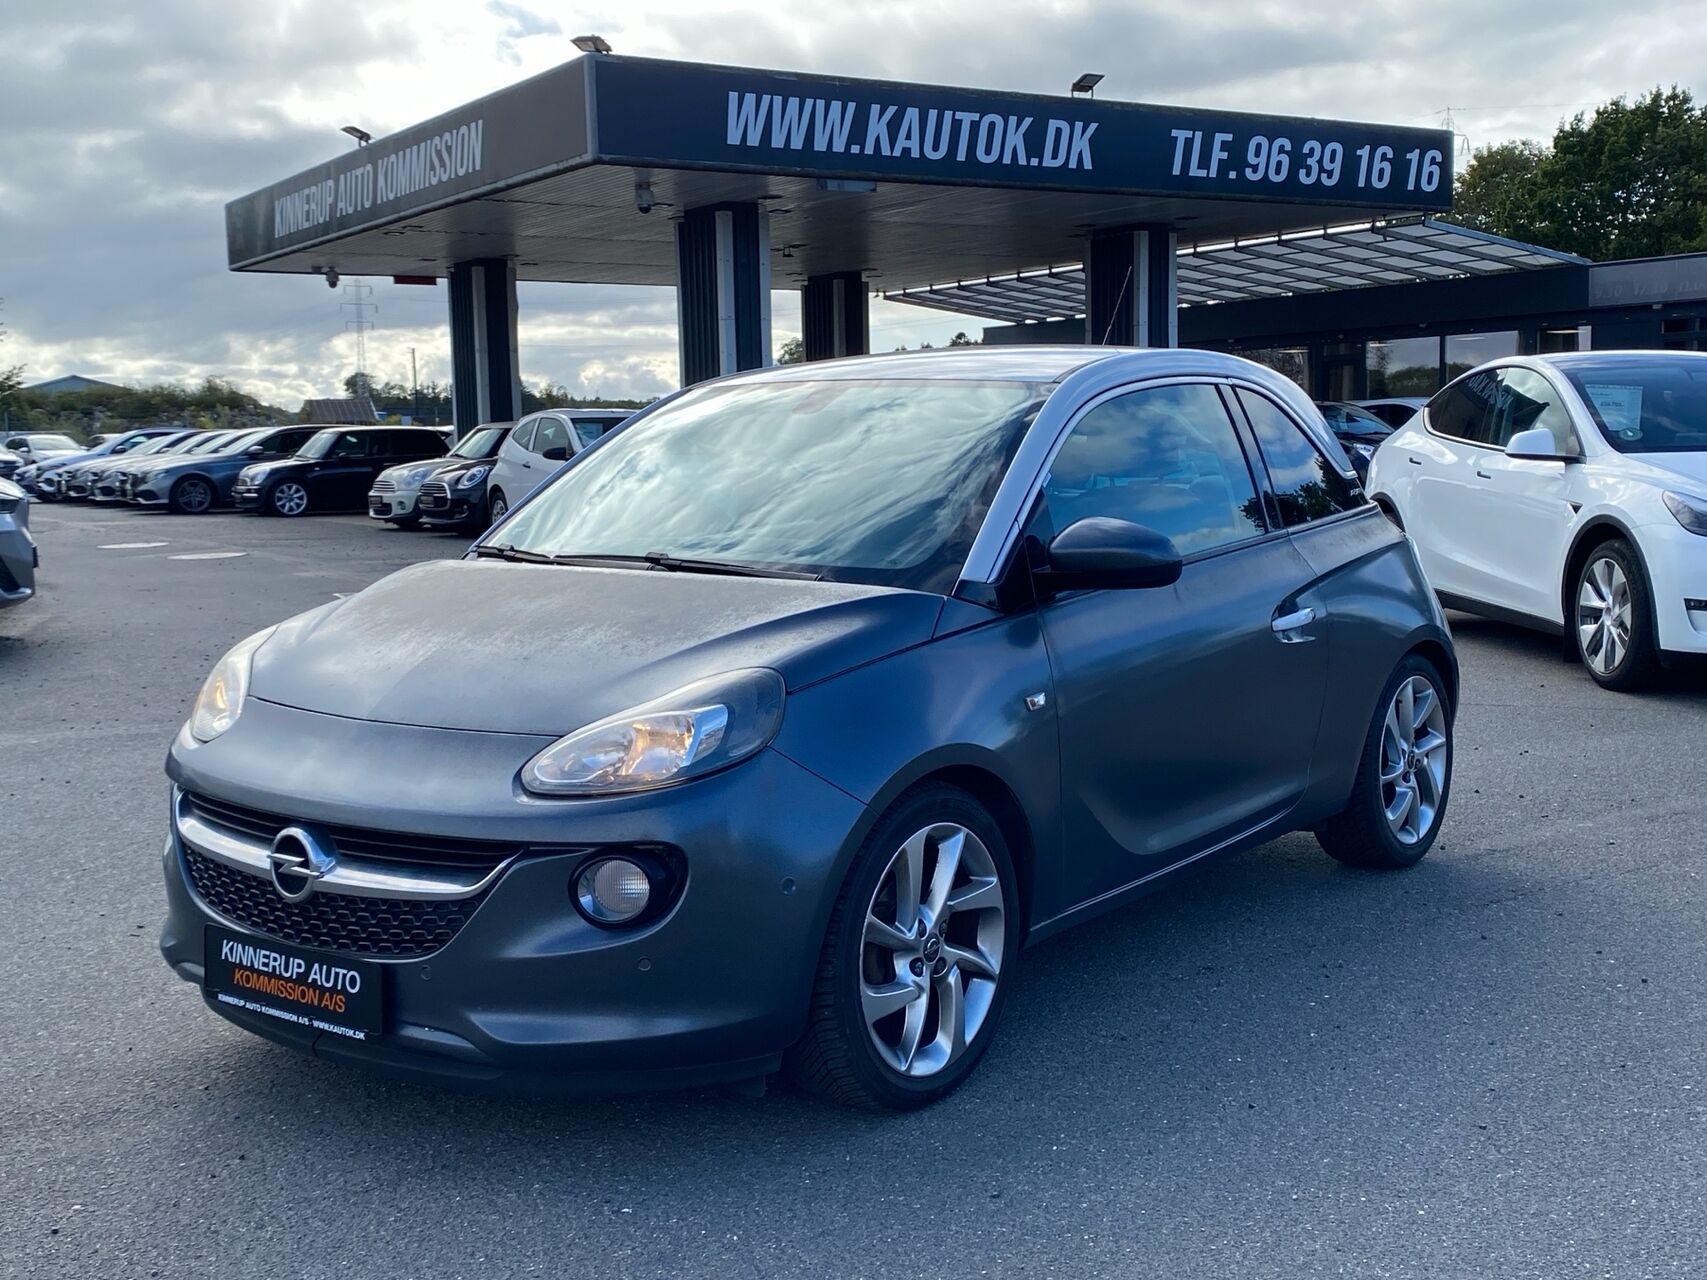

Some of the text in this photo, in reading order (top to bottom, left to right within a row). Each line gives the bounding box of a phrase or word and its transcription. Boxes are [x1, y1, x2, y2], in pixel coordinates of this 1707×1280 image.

[726, 91, 1100, 170] WWW.KAUTOK.DK
[274, 119, 484, 239] KINNERUP AUTO KOMMISSION
[1170, 129, 1442, 192] TLF. 96 39 16 16
[221, 939, 361, 994] KINNERUP AUTO
[233, 968, 346, 1013] KOMMISSION A/S
[217, 993, 245, 1007] KINNERUP
[245, 1001, 261, 1013] AUTO
[261, 1005, 298, 1023] KOMMISSION
[312, 1019, 366, 1041] WWW.KAUTOK.DK
